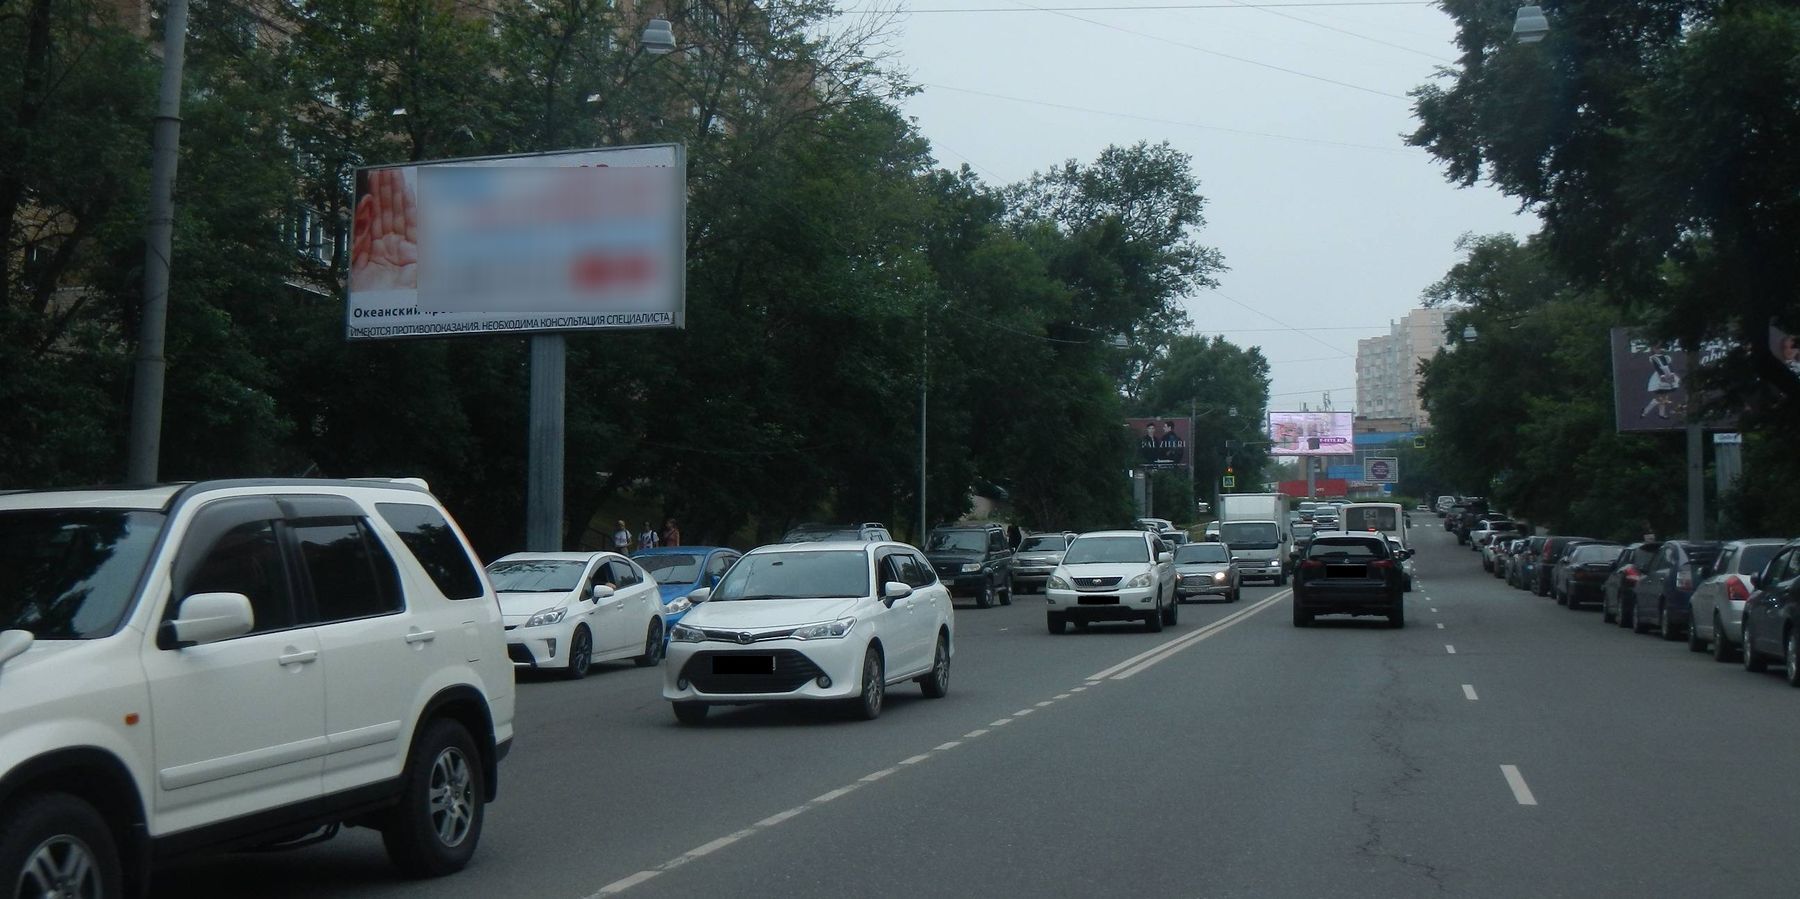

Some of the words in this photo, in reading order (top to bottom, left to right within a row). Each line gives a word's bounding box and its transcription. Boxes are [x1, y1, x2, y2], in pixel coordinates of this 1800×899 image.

[351, 326, 391, 337] ИМЕЮТСЯ
[482, 318, 539, 330] НЕОБХОДИМА
[540, 315, 605, 328] КОНСУЛЬТАЦИЯ
[606, 312, 670, 325] СПЕЦИАЛИСТА
